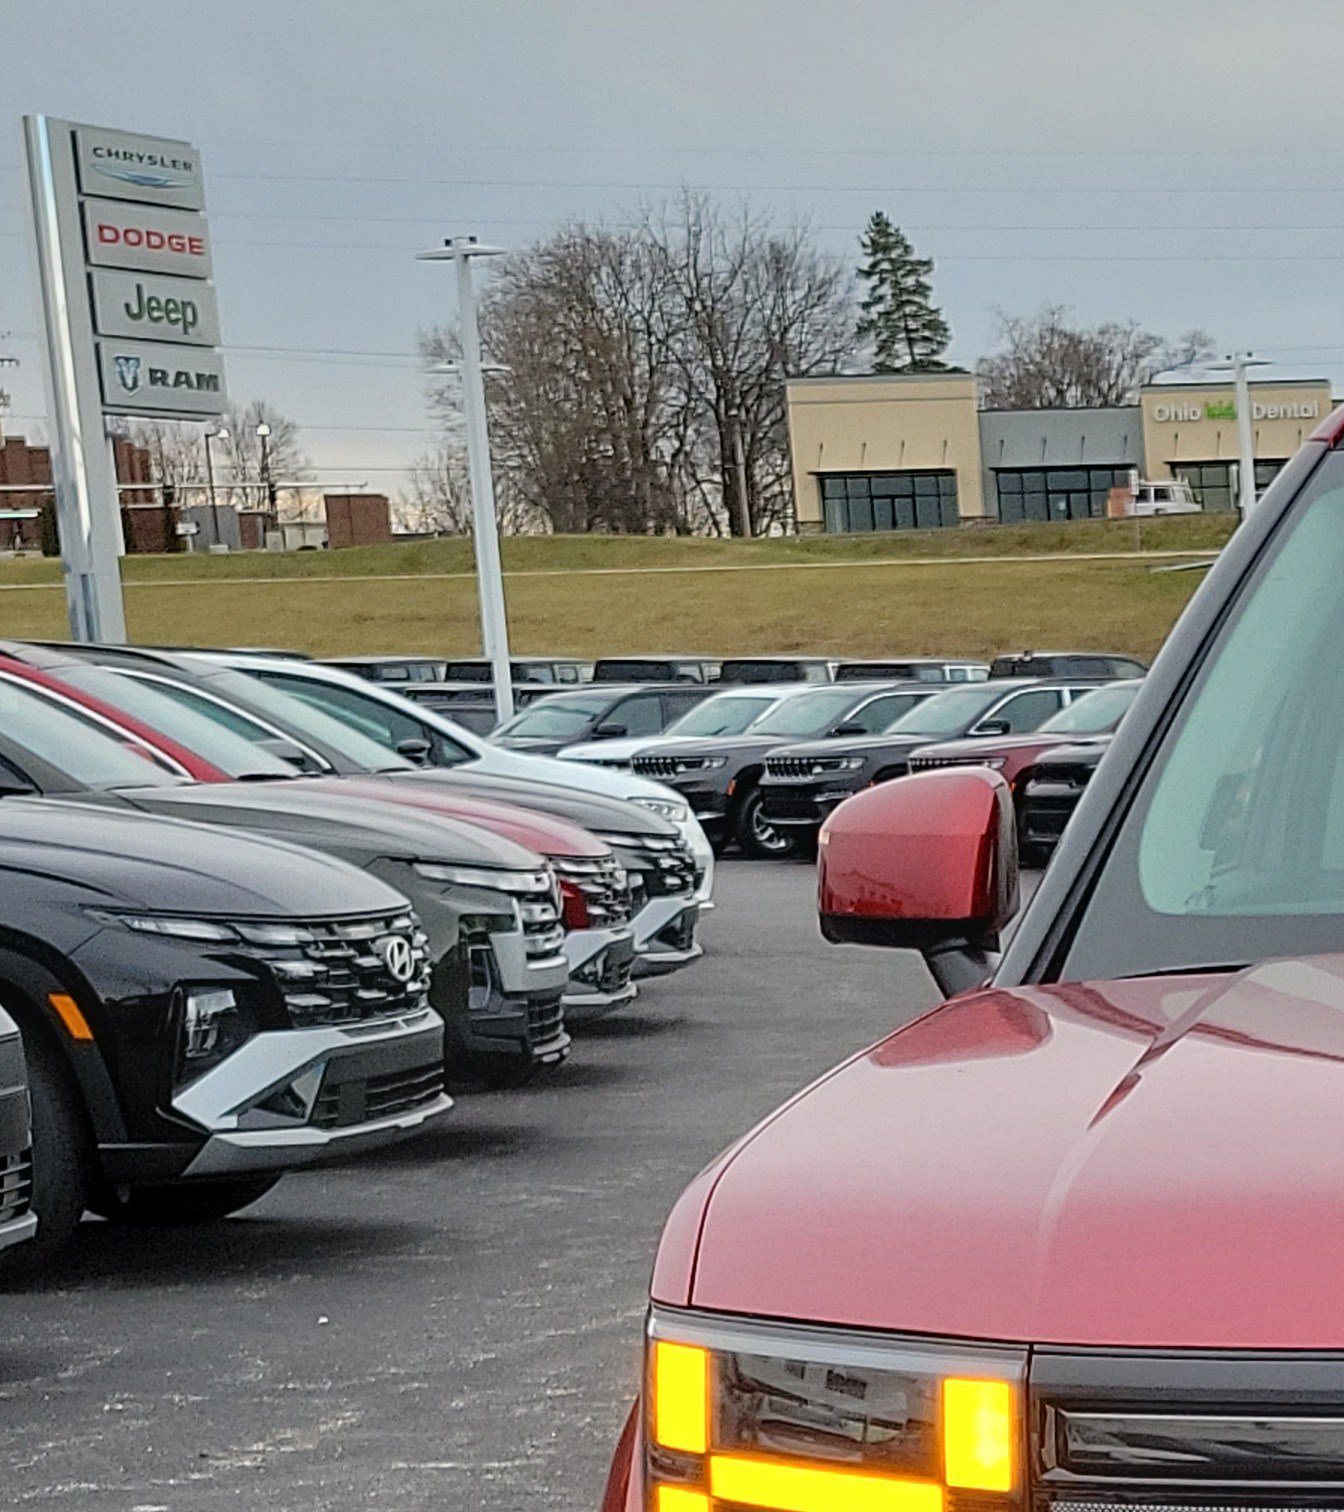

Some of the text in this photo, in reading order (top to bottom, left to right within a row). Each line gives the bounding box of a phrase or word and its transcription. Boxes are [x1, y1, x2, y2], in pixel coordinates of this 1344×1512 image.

[92, 147, 193, 172] CHRYSLER
[97, 224, 206, 256] DODGE
[124, 283, 199, 336] Jeep
[148, 367, 220, 393] RAM
[1153, 402, 1202, 422] Ohio
[1252, 401, 1319, 421] Dental
